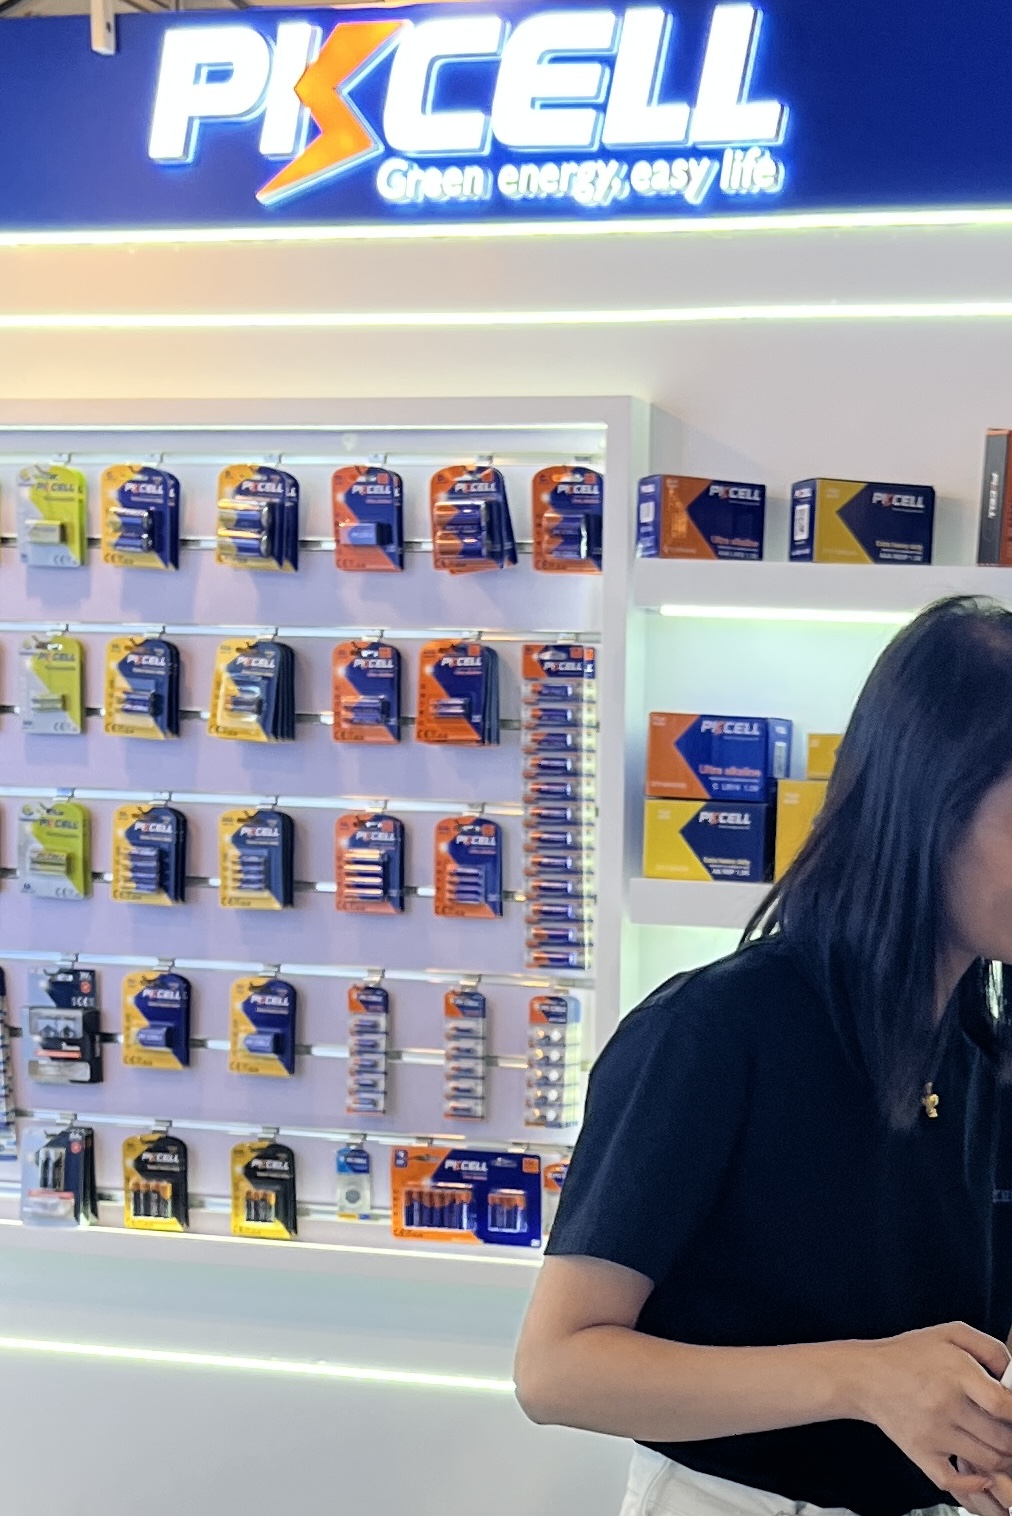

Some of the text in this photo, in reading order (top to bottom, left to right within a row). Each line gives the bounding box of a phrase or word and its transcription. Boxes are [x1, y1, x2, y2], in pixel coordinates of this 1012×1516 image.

[148, 4, 785, 204] PKCELL
[376, 158, 489, 202] Green
[720, 147, 782, 194] life
[709, 485, 761, 501] PKCELL
[872, 492, 925, 508] PKCELL
[701, 720, 760, 736] PKCELL
[698, 811, 751, 826] PKCELL
[444, 1159, 488, 1172] PKCELL
